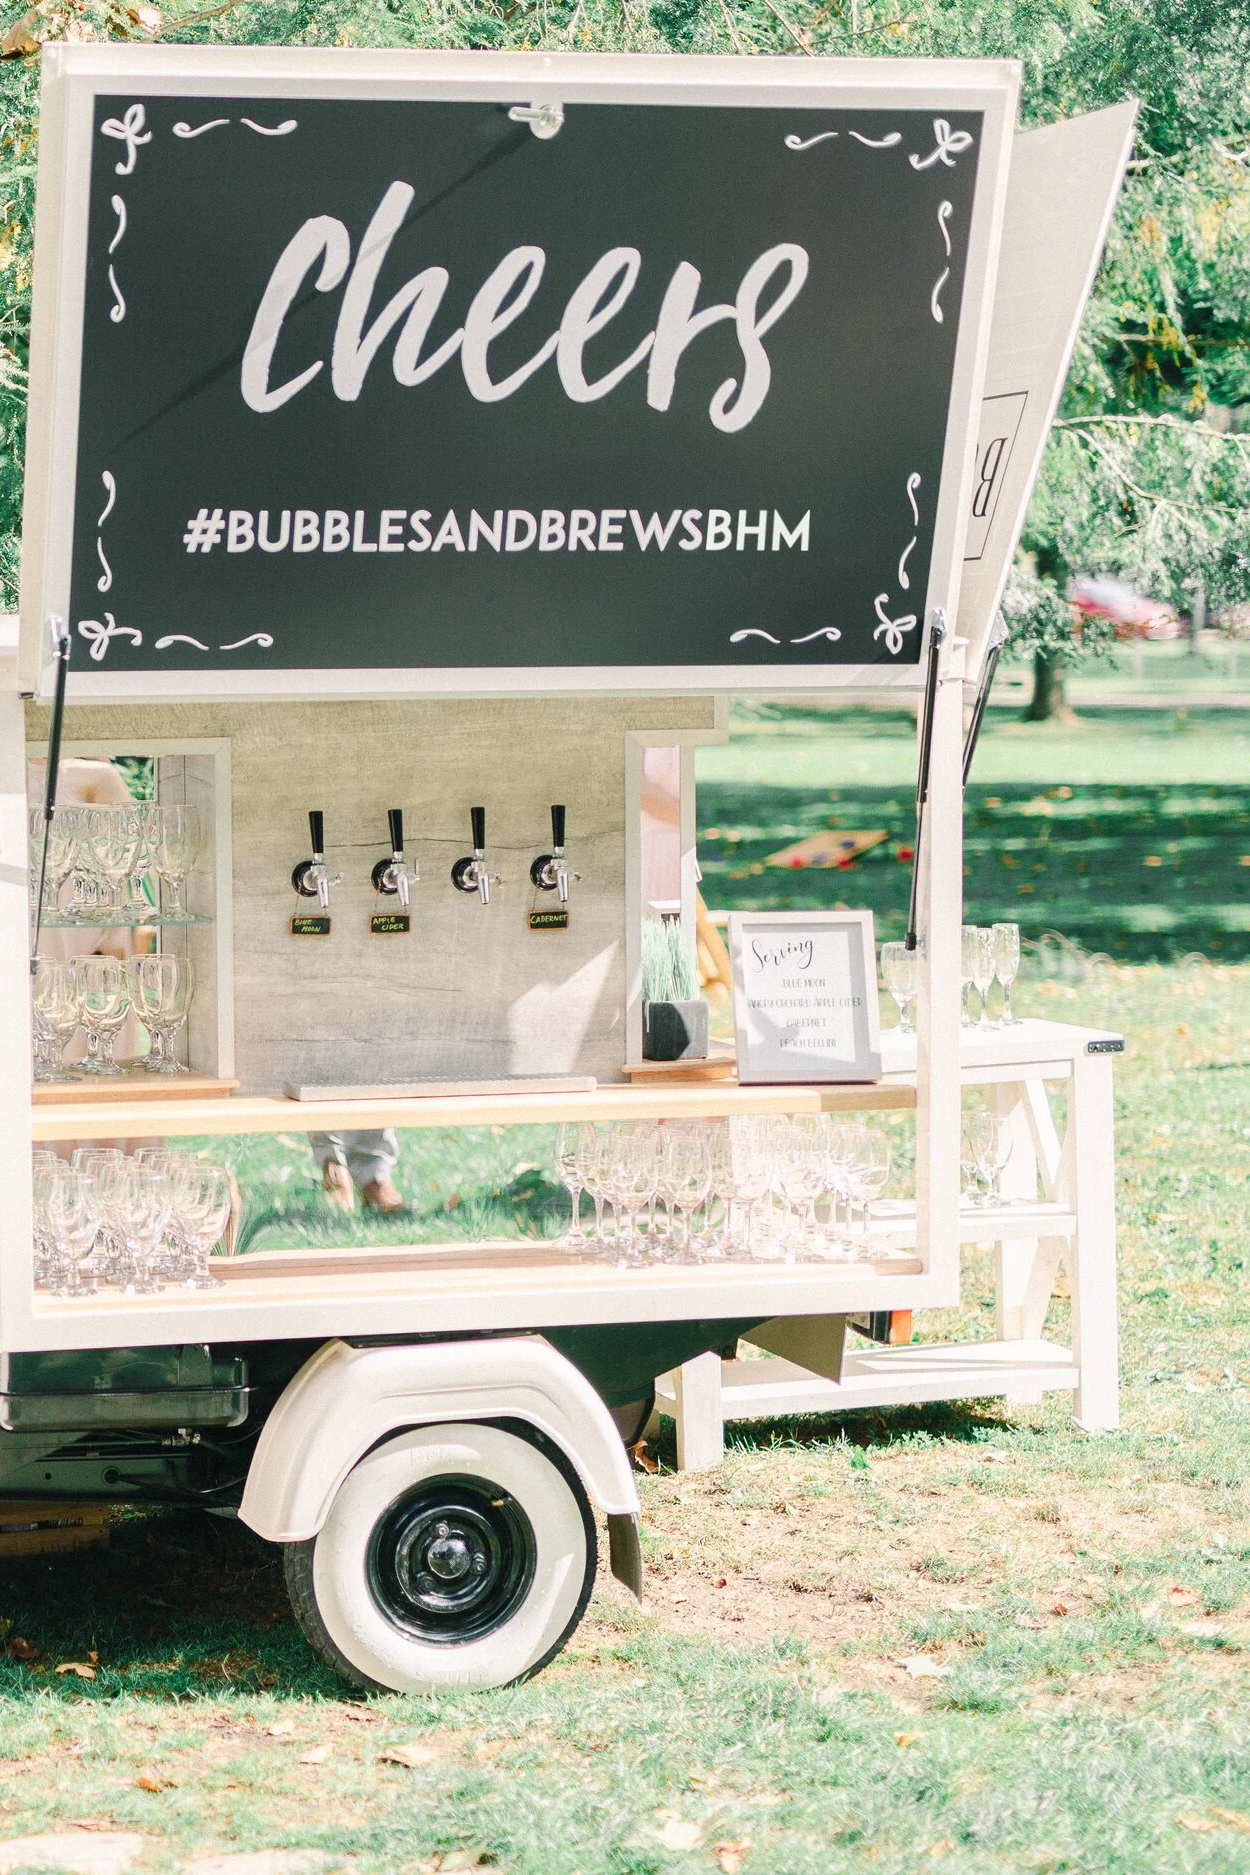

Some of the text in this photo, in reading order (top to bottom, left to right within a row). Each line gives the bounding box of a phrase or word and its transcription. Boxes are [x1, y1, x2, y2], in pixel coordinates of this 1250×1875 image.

[241, 181, 809, 433] Cheers
[183, 509, 810, 552] #BUBBLESANDBREWSBHM
[373, 917, 396, 925] APPLE
[381, 923, 404, 931] CIDER
[531, 914, 568, 924] CABERNET
[751, 938, 814, 974] Serving
